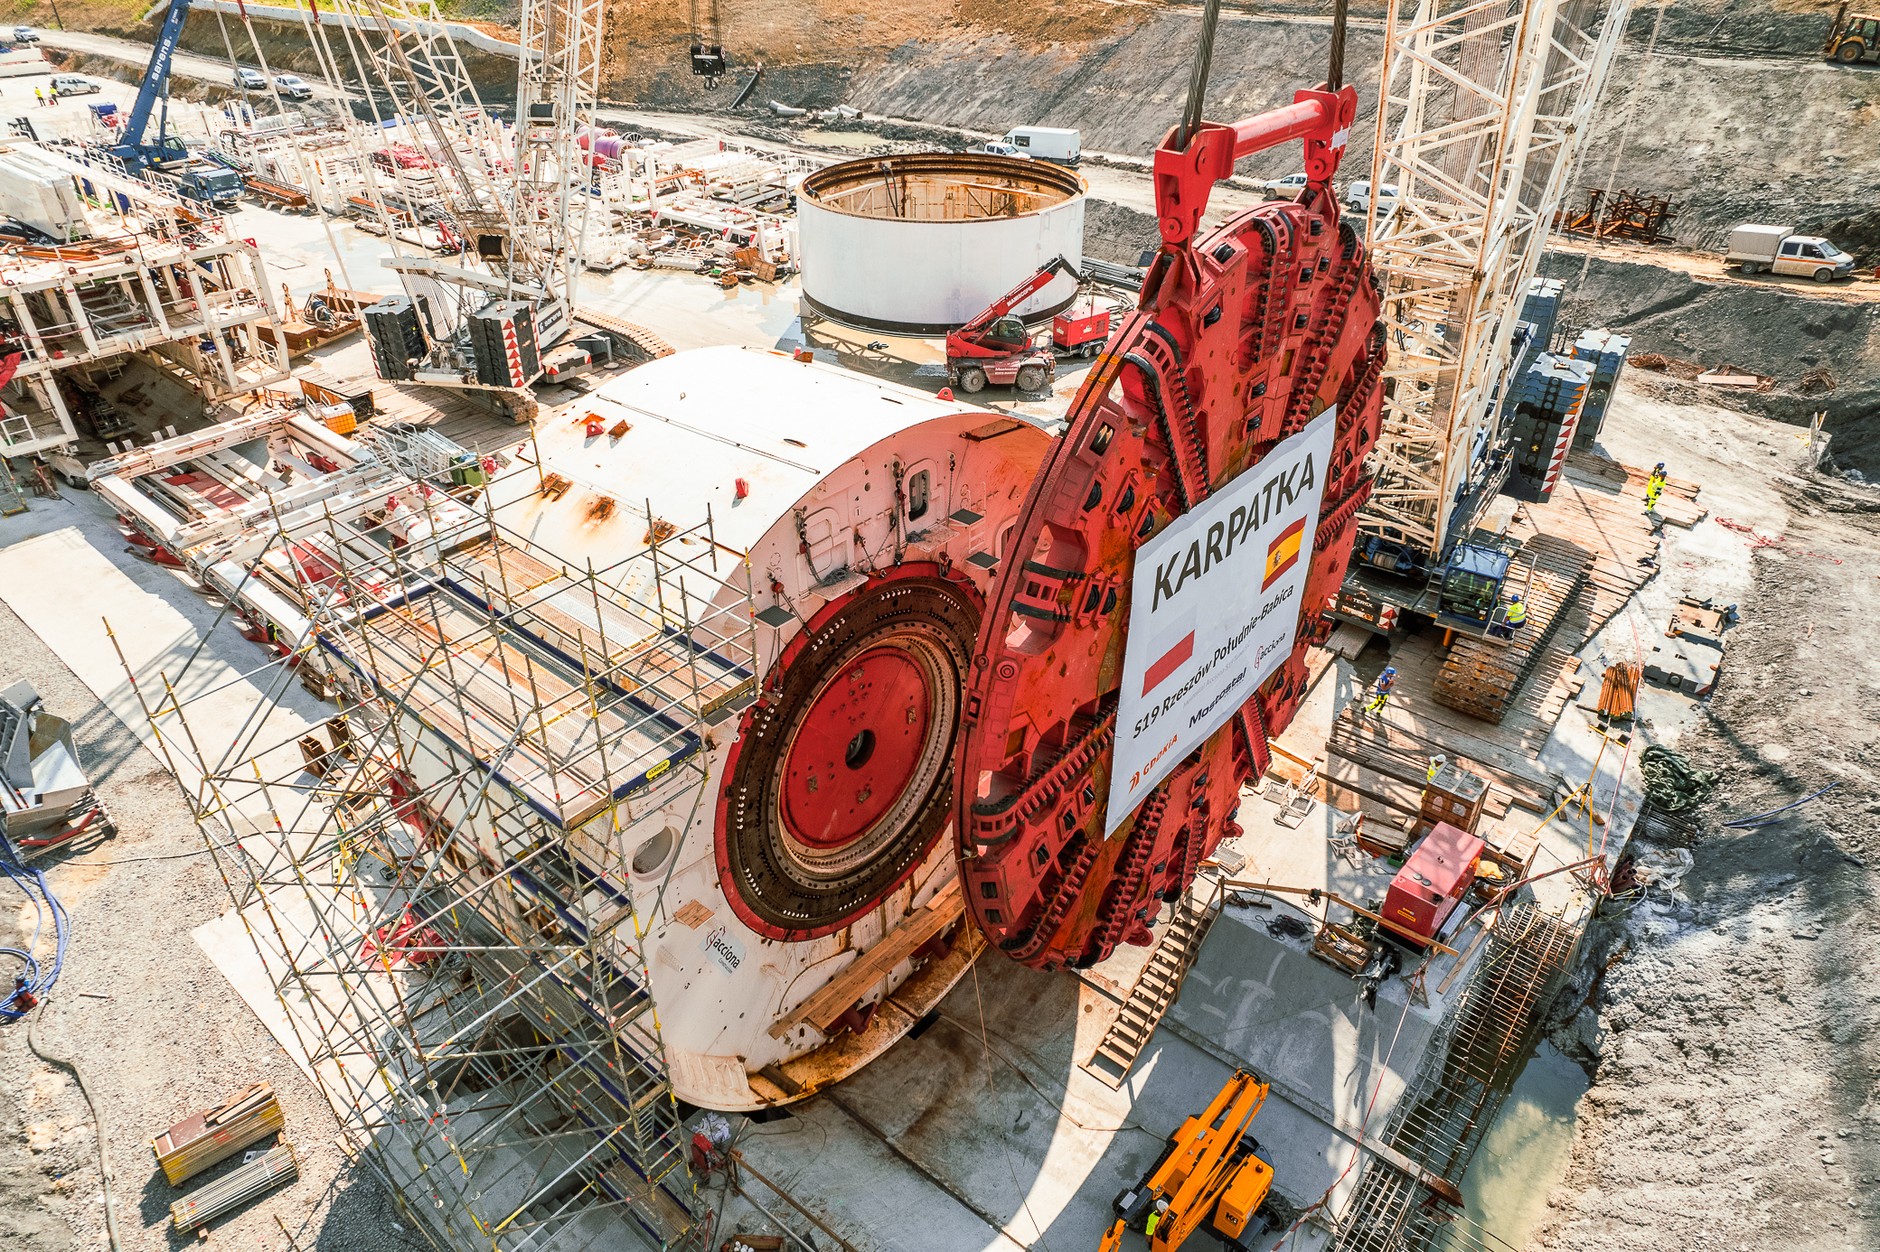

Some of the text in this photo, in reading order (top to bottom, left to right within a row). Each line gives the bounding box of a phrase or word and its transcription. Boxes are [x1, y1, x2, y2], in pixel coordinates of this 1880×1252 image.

[152, 39, 172, 80] sarens
[1151, 452, 1315, 614] KARPATKA
[1352, 597, 1374, 609] TEREX
[1132, 704, 1161, 739] S19
[1161, 660, 1214, 717] Rzeszów
[1213, 584, 1295, 668] Południe-Babica
[1259, 632, 1286, 661] acciona
[1188, 666, 1248, 729] Mostostal
[712, 938, 741, 969] acciona
